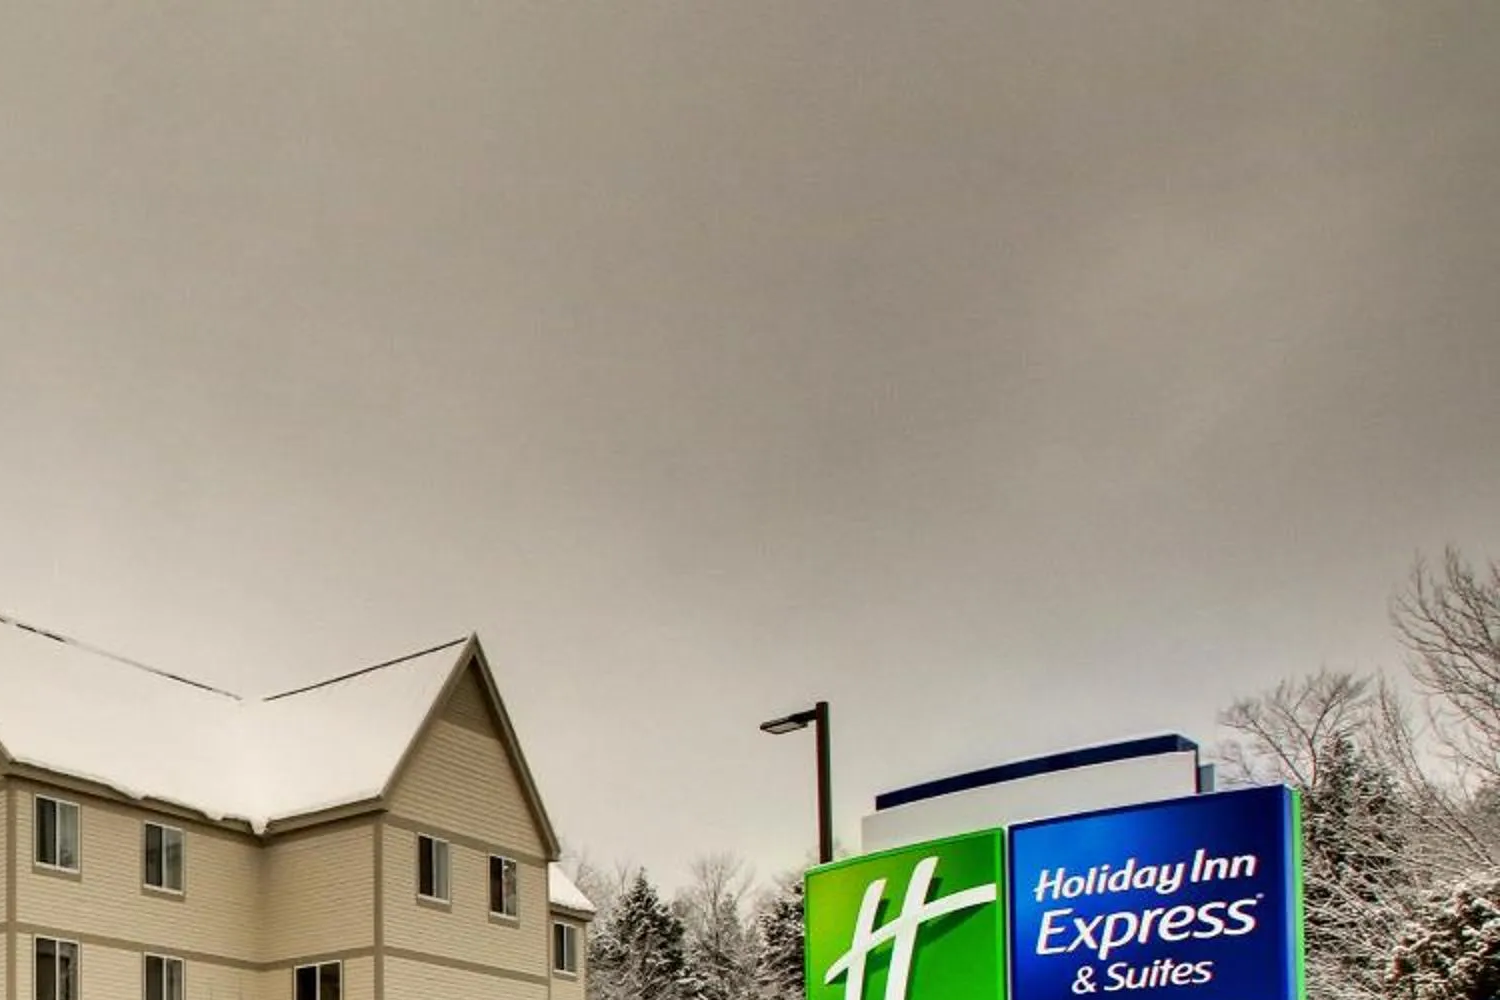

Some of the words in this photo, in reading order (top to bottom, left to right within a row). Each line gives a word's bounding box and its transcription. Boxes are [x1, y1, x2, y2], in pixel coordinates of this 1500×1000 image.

[1033, 857, 1184, 902] Holiday
[1190, 848, 1257, 883] Inn
[1035, 898, 1258, 961] Express
[1071, 965, 1097, 995] &
[1103, 957, 1214, 992] Suites
